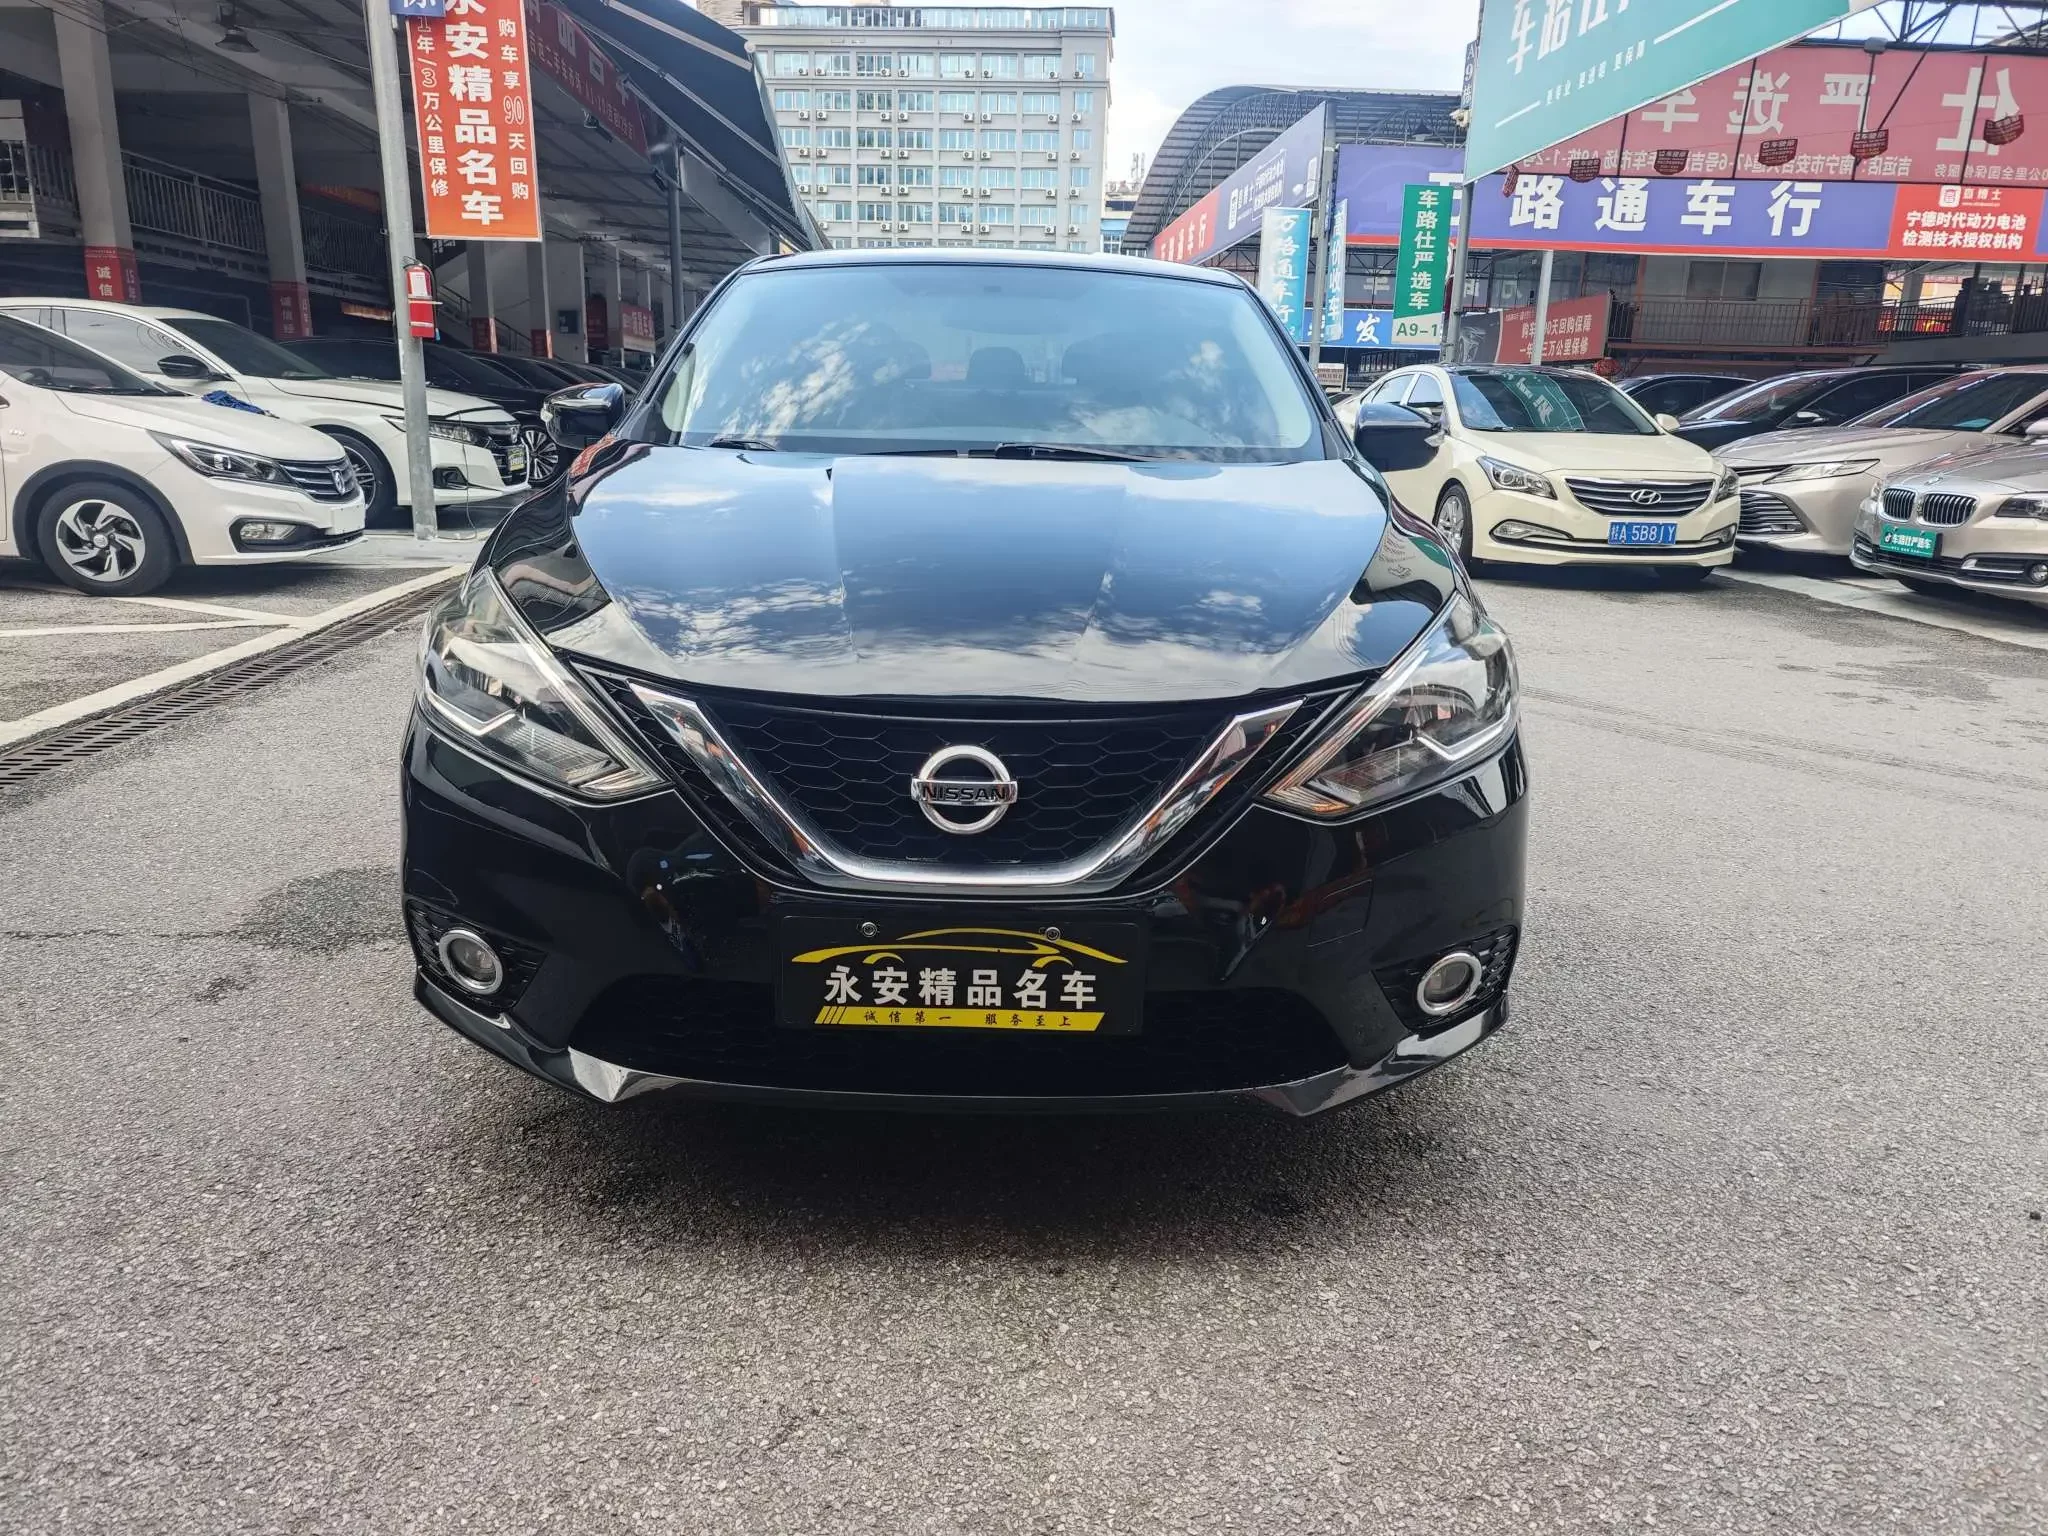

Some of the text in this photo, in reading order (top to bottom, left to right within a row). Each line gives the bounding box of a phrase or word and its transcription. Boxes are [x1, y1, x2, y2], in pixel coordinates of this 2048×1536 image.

[498, 18, 529, 200] 购车享90天回购
[1906, 210, 2027, 230] 宁德时代动力电池
[1408, 190, 1440, 310] 车路仕严选车
[1902, 230, 2023, 249] 检测技术授权机构
[96, 265, 113, 297] 诚信
[922, 785, 1009, 801] NISSAN
[824, 965, 1097, 1010] 永安精品名车
[863, 1010, 1072, 1027] 诚信第一 服务至上
